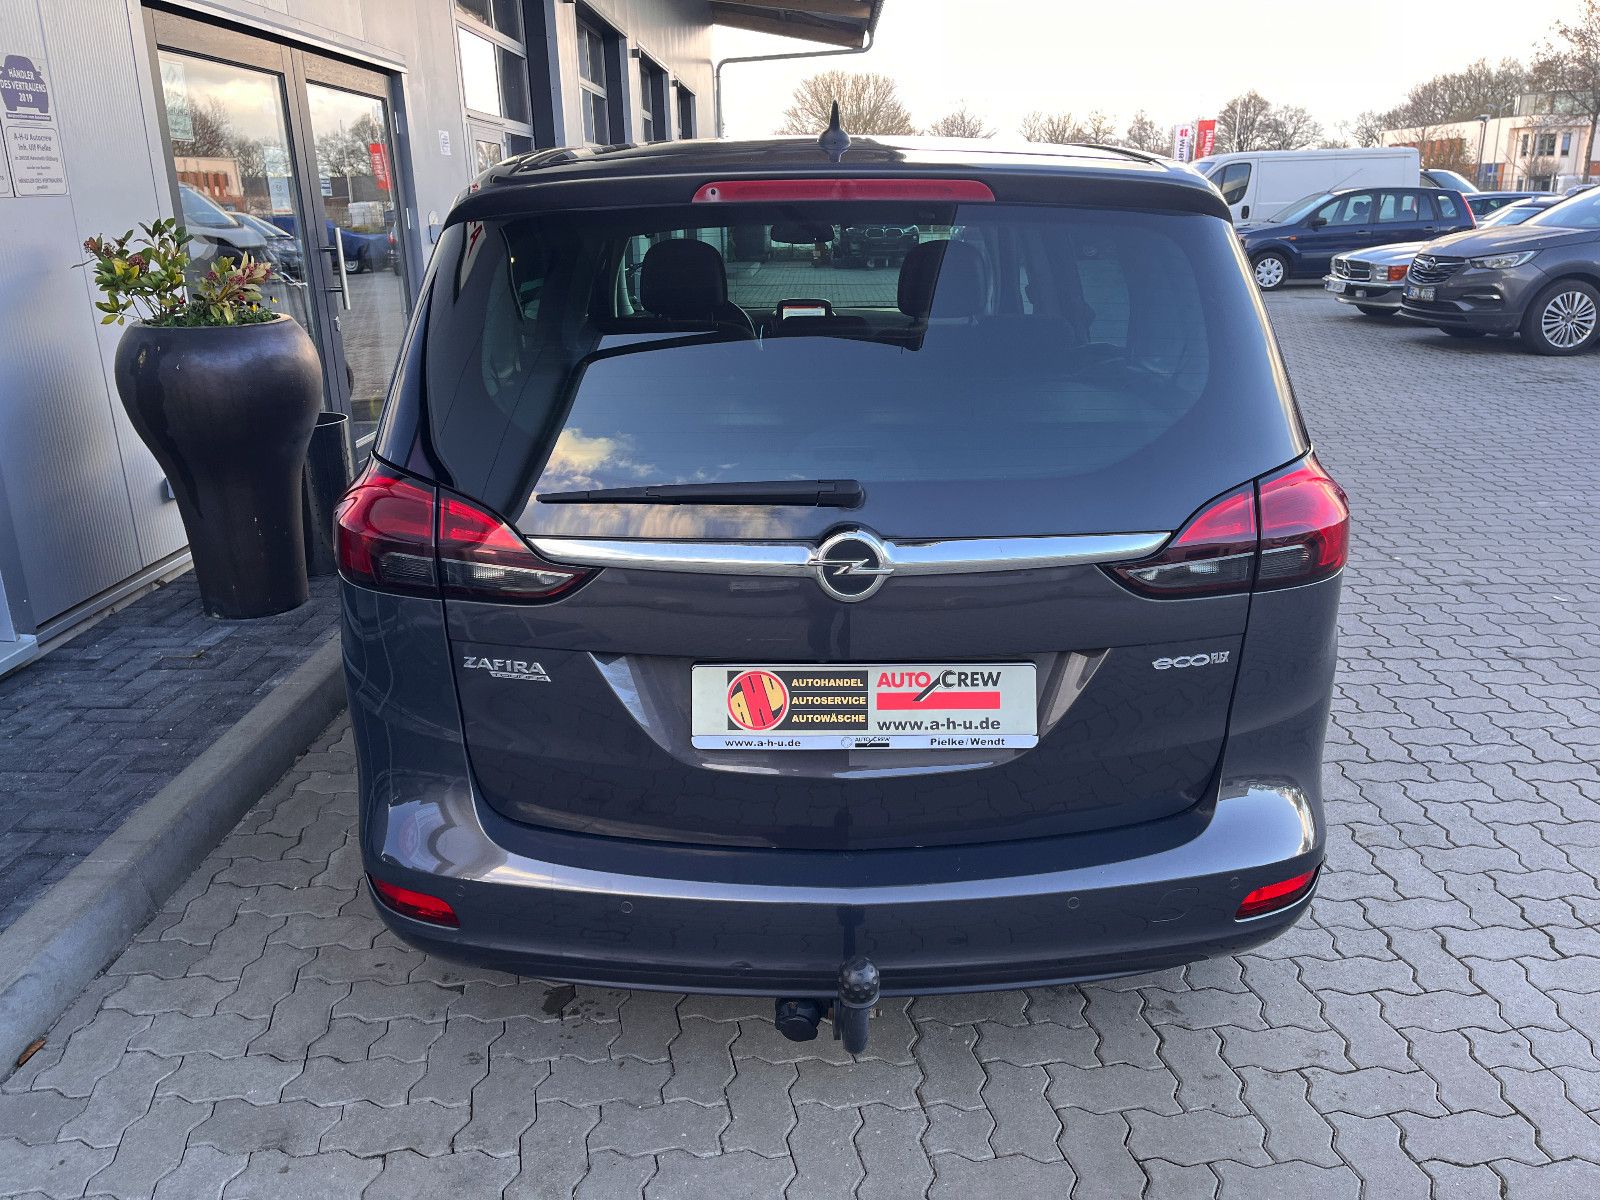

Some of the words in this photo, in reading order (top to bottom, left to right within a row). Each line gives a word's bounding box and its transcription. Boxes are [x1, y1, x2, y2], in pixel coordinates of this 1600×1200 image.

[8, 67, 34, 80] HÄNDLER
[0, 80, 12, 89] DES
[12, 81, 47, 93] VERTRAUENS
[19, 93, 33, 103] 2019
[463, 656, 547, 675] ZAFIRA
[791, 678, 864, 687] AUTOHANDEL
[876, 672, 932, 688] AUTO
[941, 670, 1002, 688] CREW
[791, 696, 867, 705] AUTOSERVICE
[791, 713, 866, 723] AUTOWÄSCHE
[877, 717, 1001, 731] www.a-h-u.de
[724, 739, 801, 747] www.a-h-u.de
